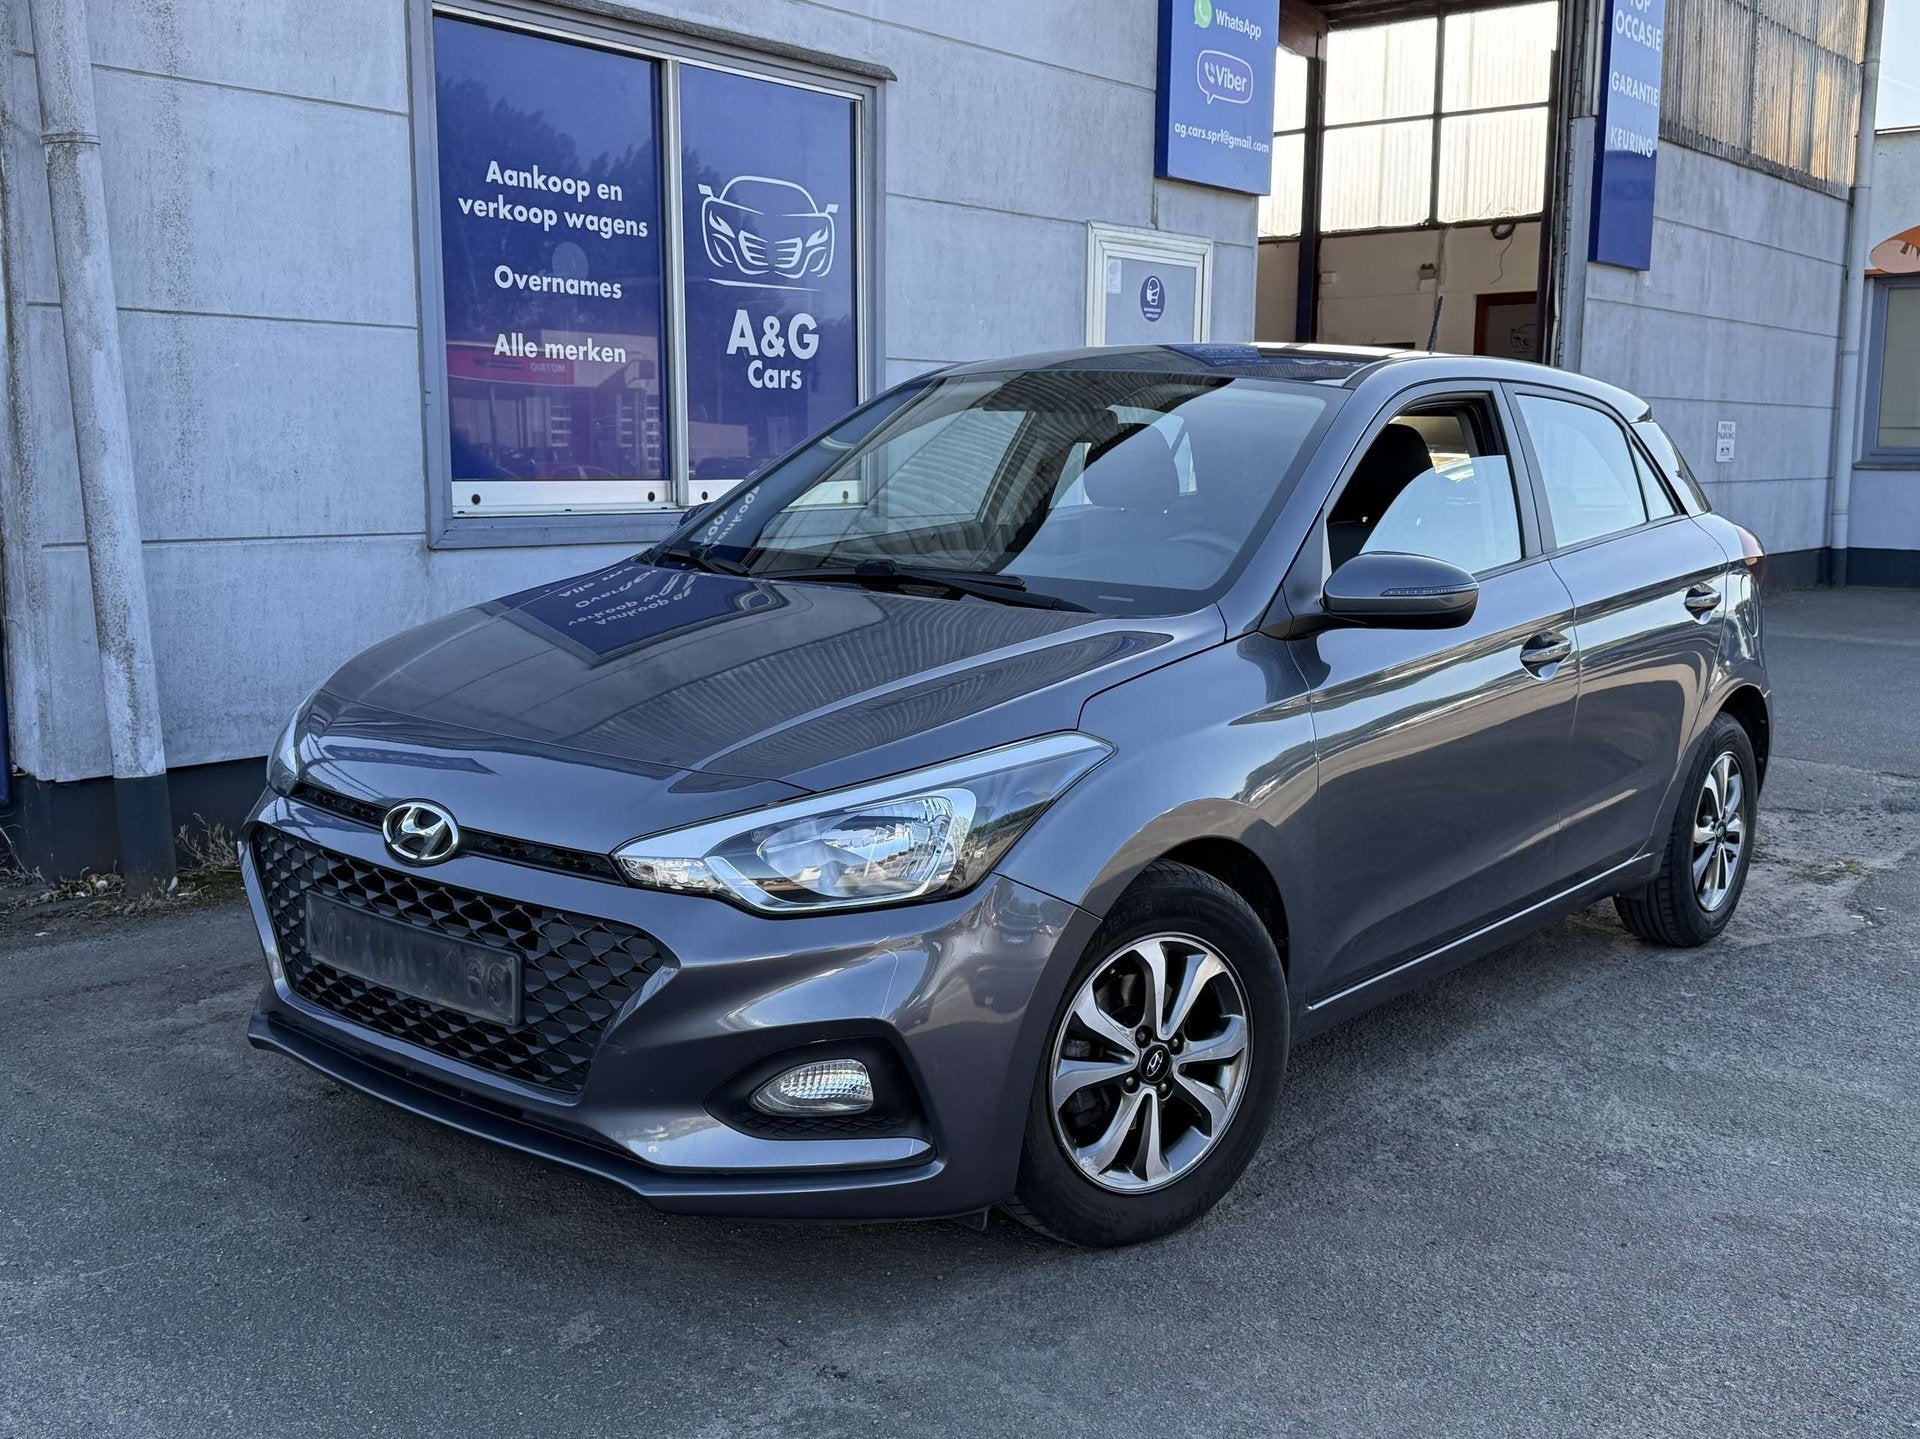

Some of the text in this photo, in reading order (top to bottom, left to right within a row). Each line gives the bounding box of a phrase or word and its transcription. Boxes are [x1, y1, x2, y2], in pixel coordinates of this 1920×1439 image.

[1215, 8, 1261, 41] WhatsApp
[1615, 9, 1662, 51] OCCASIE
[1215, 64, 1247, 93] Viber
[1611, 70, 1659, 107] GARANTIE
[1174, 122, 1270, 154] ag.cars.sprl@gmail.com
[1610, 125, 1653, 158] KEURING
[486, 160, 623, 202] Aankoop en
[457, 194, 649, 239] verkoop wagens
[494, 264, 623, 299] Overnames
[493, 332, 627, 363] Alle merken
[726, 309, 820, 360] A&G
[747, 359, 802, 390] Cars
